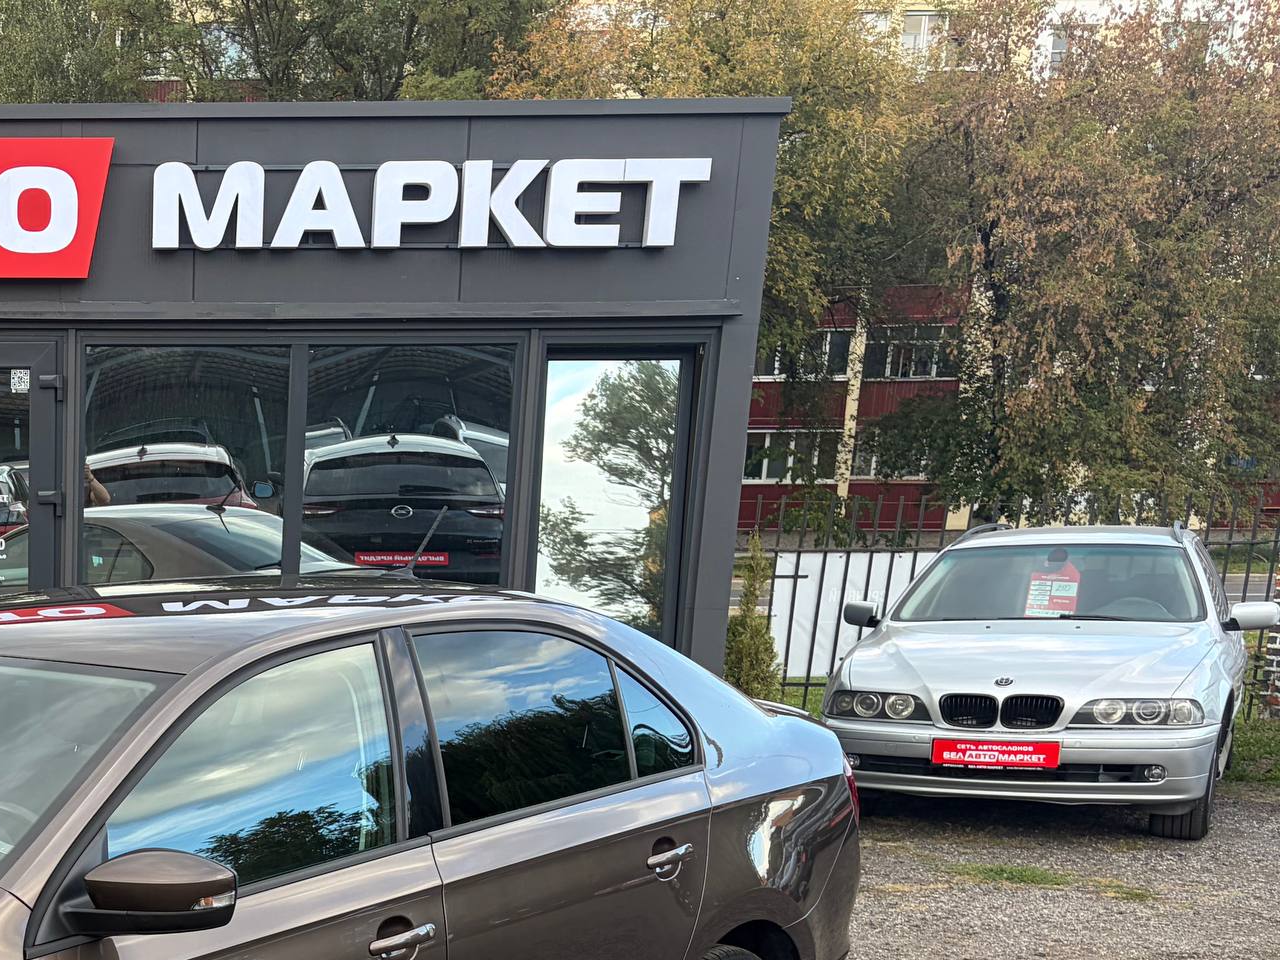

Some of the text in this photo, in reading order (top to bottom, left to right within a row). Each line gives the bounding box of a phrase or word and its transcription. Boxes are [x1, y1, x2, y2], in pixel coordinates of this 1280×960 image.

[151, 156, 714, 251] МАРКЕТ
[943, 752, 1046, 762] БЕЛ АВТО МАРКЕТ
